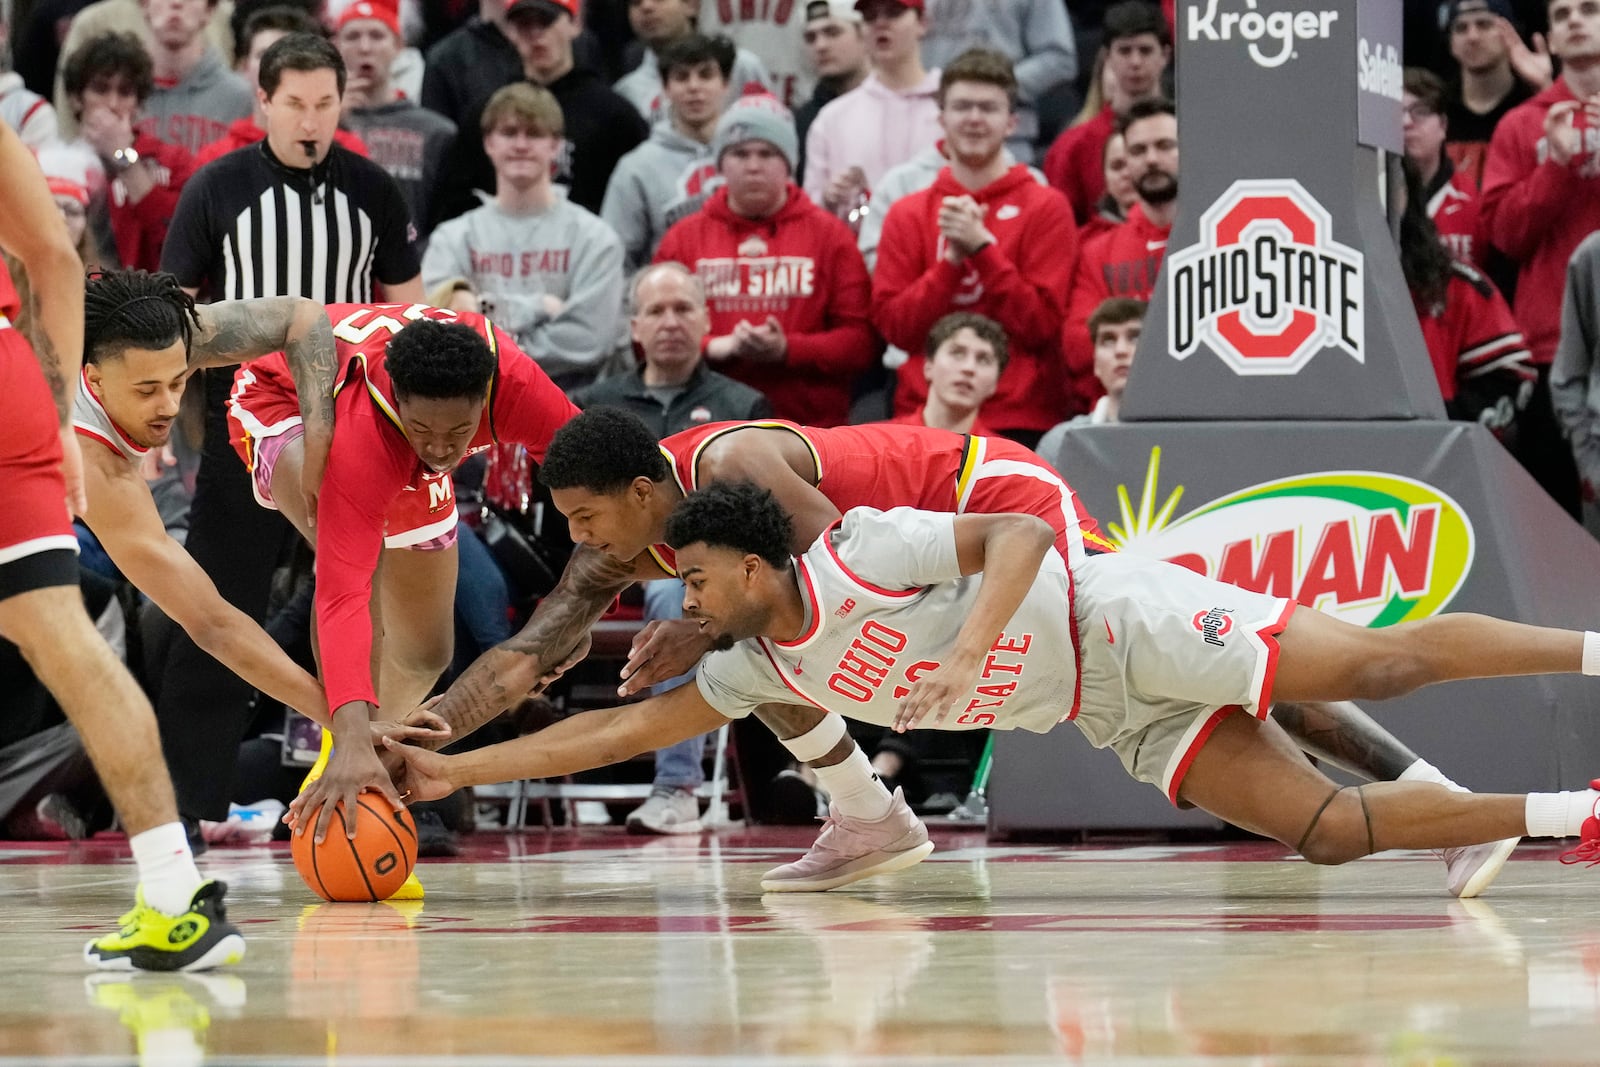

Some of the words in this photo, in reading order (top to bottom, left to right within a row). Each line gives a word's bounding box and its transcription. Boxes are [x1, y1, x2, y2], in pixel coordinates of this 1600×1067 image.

[1188, 0, 1338, 67] Kroger
[747, 256, 815, 297] STATE
[1175, 248, 1249, 353] OHIO
[1255, 236, 1359, 351] STATE
[827, 619, 908, 703] OHIO
[956, 632, 1033, 726] STATE
